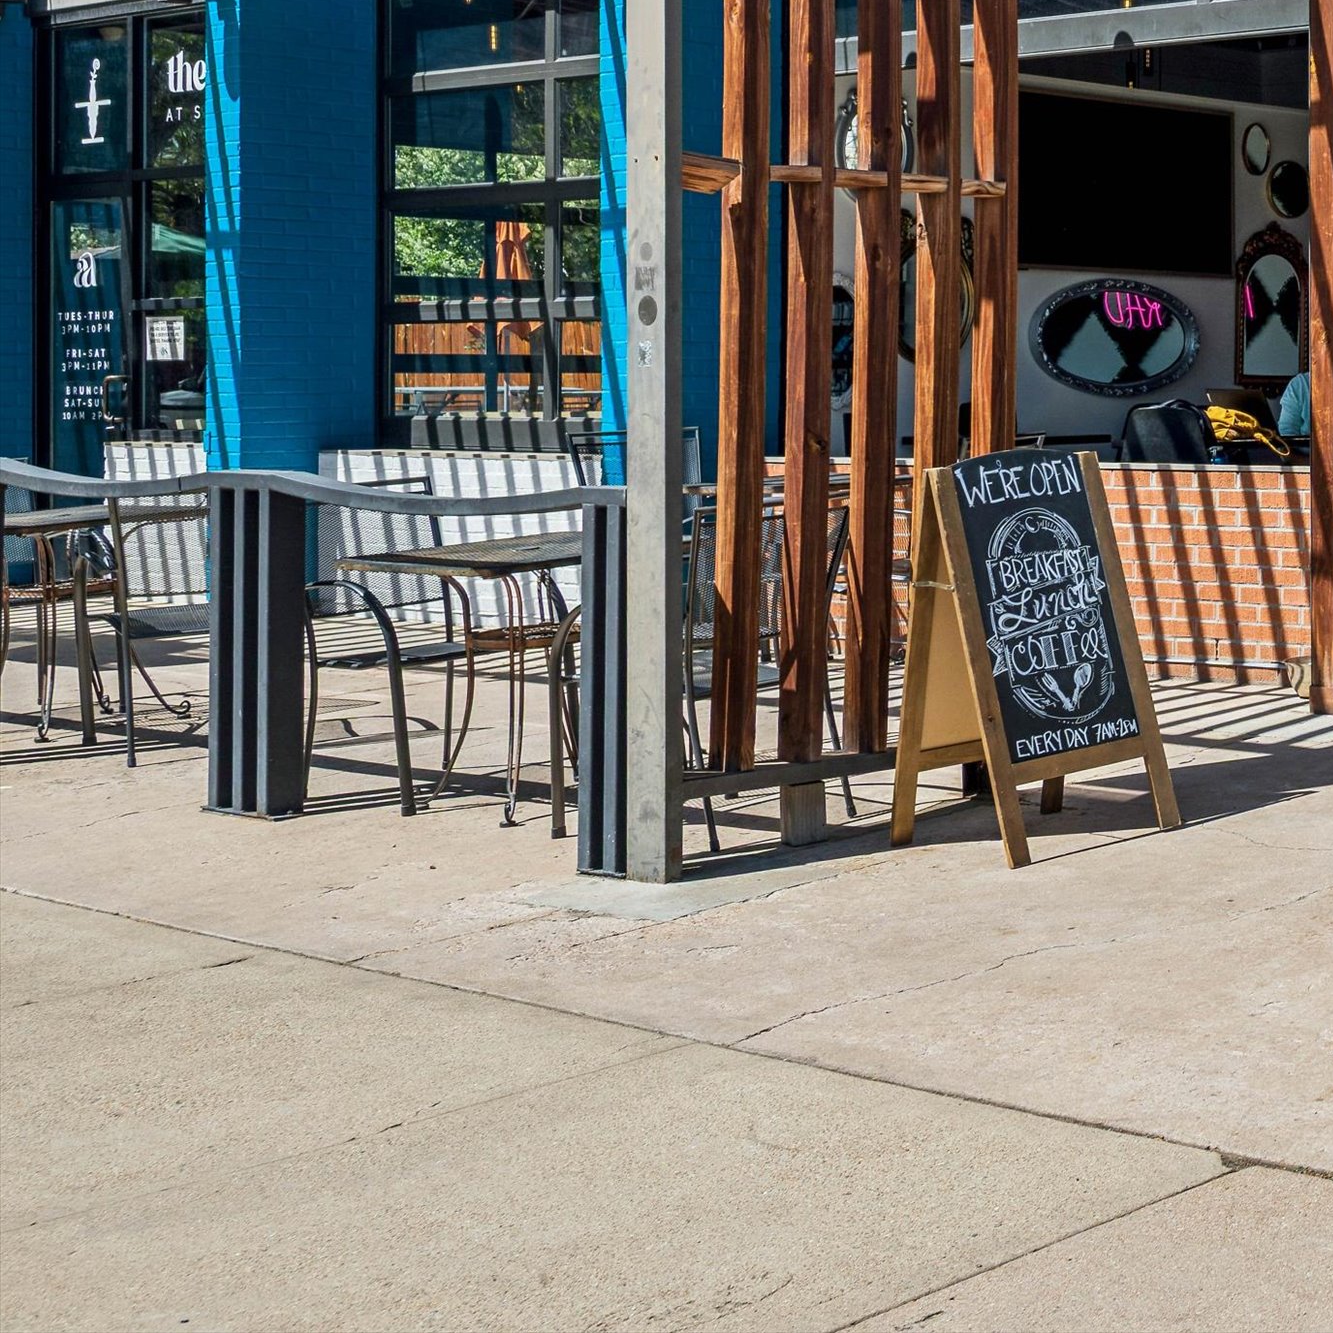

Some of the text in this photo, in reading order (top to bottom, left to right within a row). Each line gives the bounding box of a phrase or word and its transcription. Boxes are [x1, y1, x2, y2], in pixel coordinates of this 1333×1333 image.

[167, 50, 206, 93] the
[165, 107, 183, 122] AT
[57, 310, 115, 321] TUES-THUR
[61, 323, 111, 335] 3PM-10PM
[66, 348, 106, 358] FRI-SAT
[61, 360, 110, 372] 3PM-11PM
[63, 398, 104, 408] SAT-SU
[953, 455, 1081, 507] WE'RE OPEN
[1000, 548, 1085, 589] BREAKFAST
[998, 571, 1098, 632] Lunch
[1091, 718, 1139, 743] 7AM-2PM
